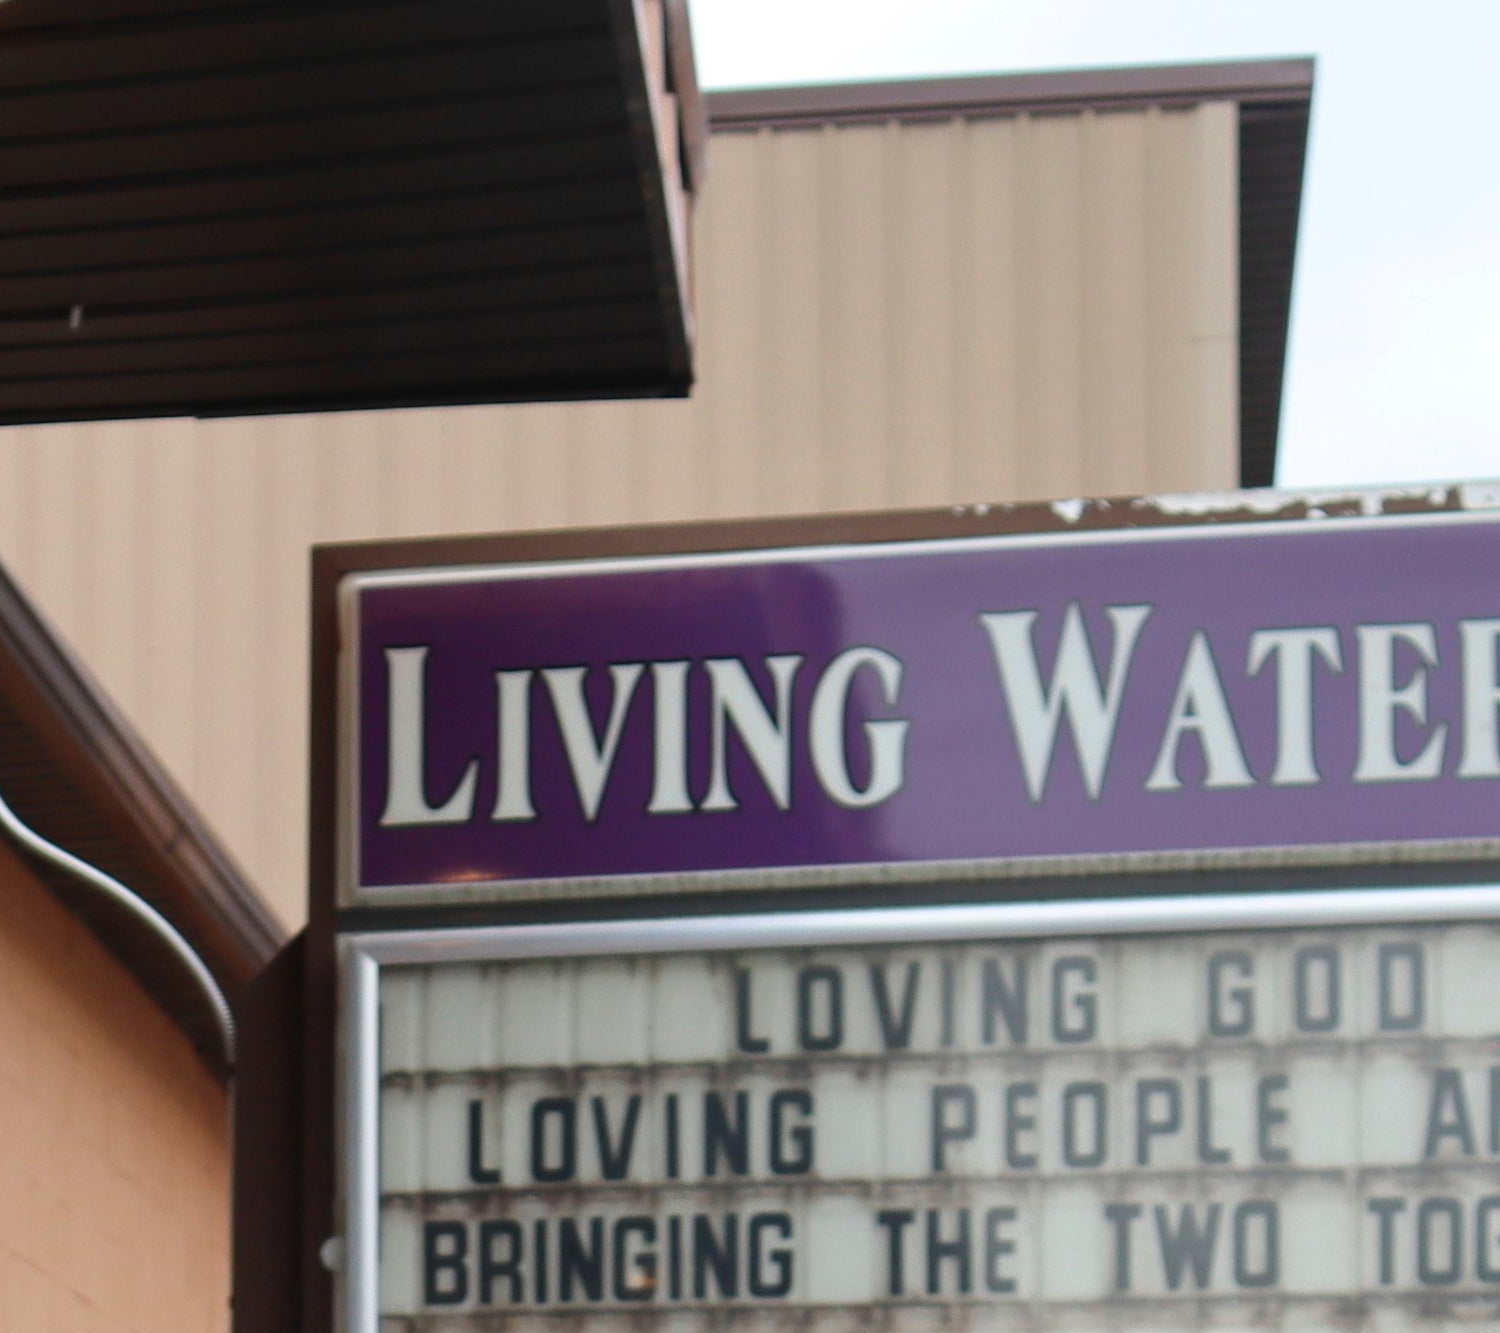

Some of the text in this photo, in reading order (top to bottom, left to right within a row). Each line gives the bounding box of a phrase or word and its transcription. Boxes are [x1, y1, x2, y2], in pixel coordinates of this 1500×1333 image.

[378, 643, 911, 828] LIVING
[734, 942, 1426, 1054] LOVING GOD
[468, 1088, 816, 1184] LOVING
[930, 1074, 1291, 1173] PEOPLE
[423, 1212, 794, 1305] BRINGING
[877, 1206, 1018, 1296] THE
[1106, 1201, 1280, 1291] TWO
